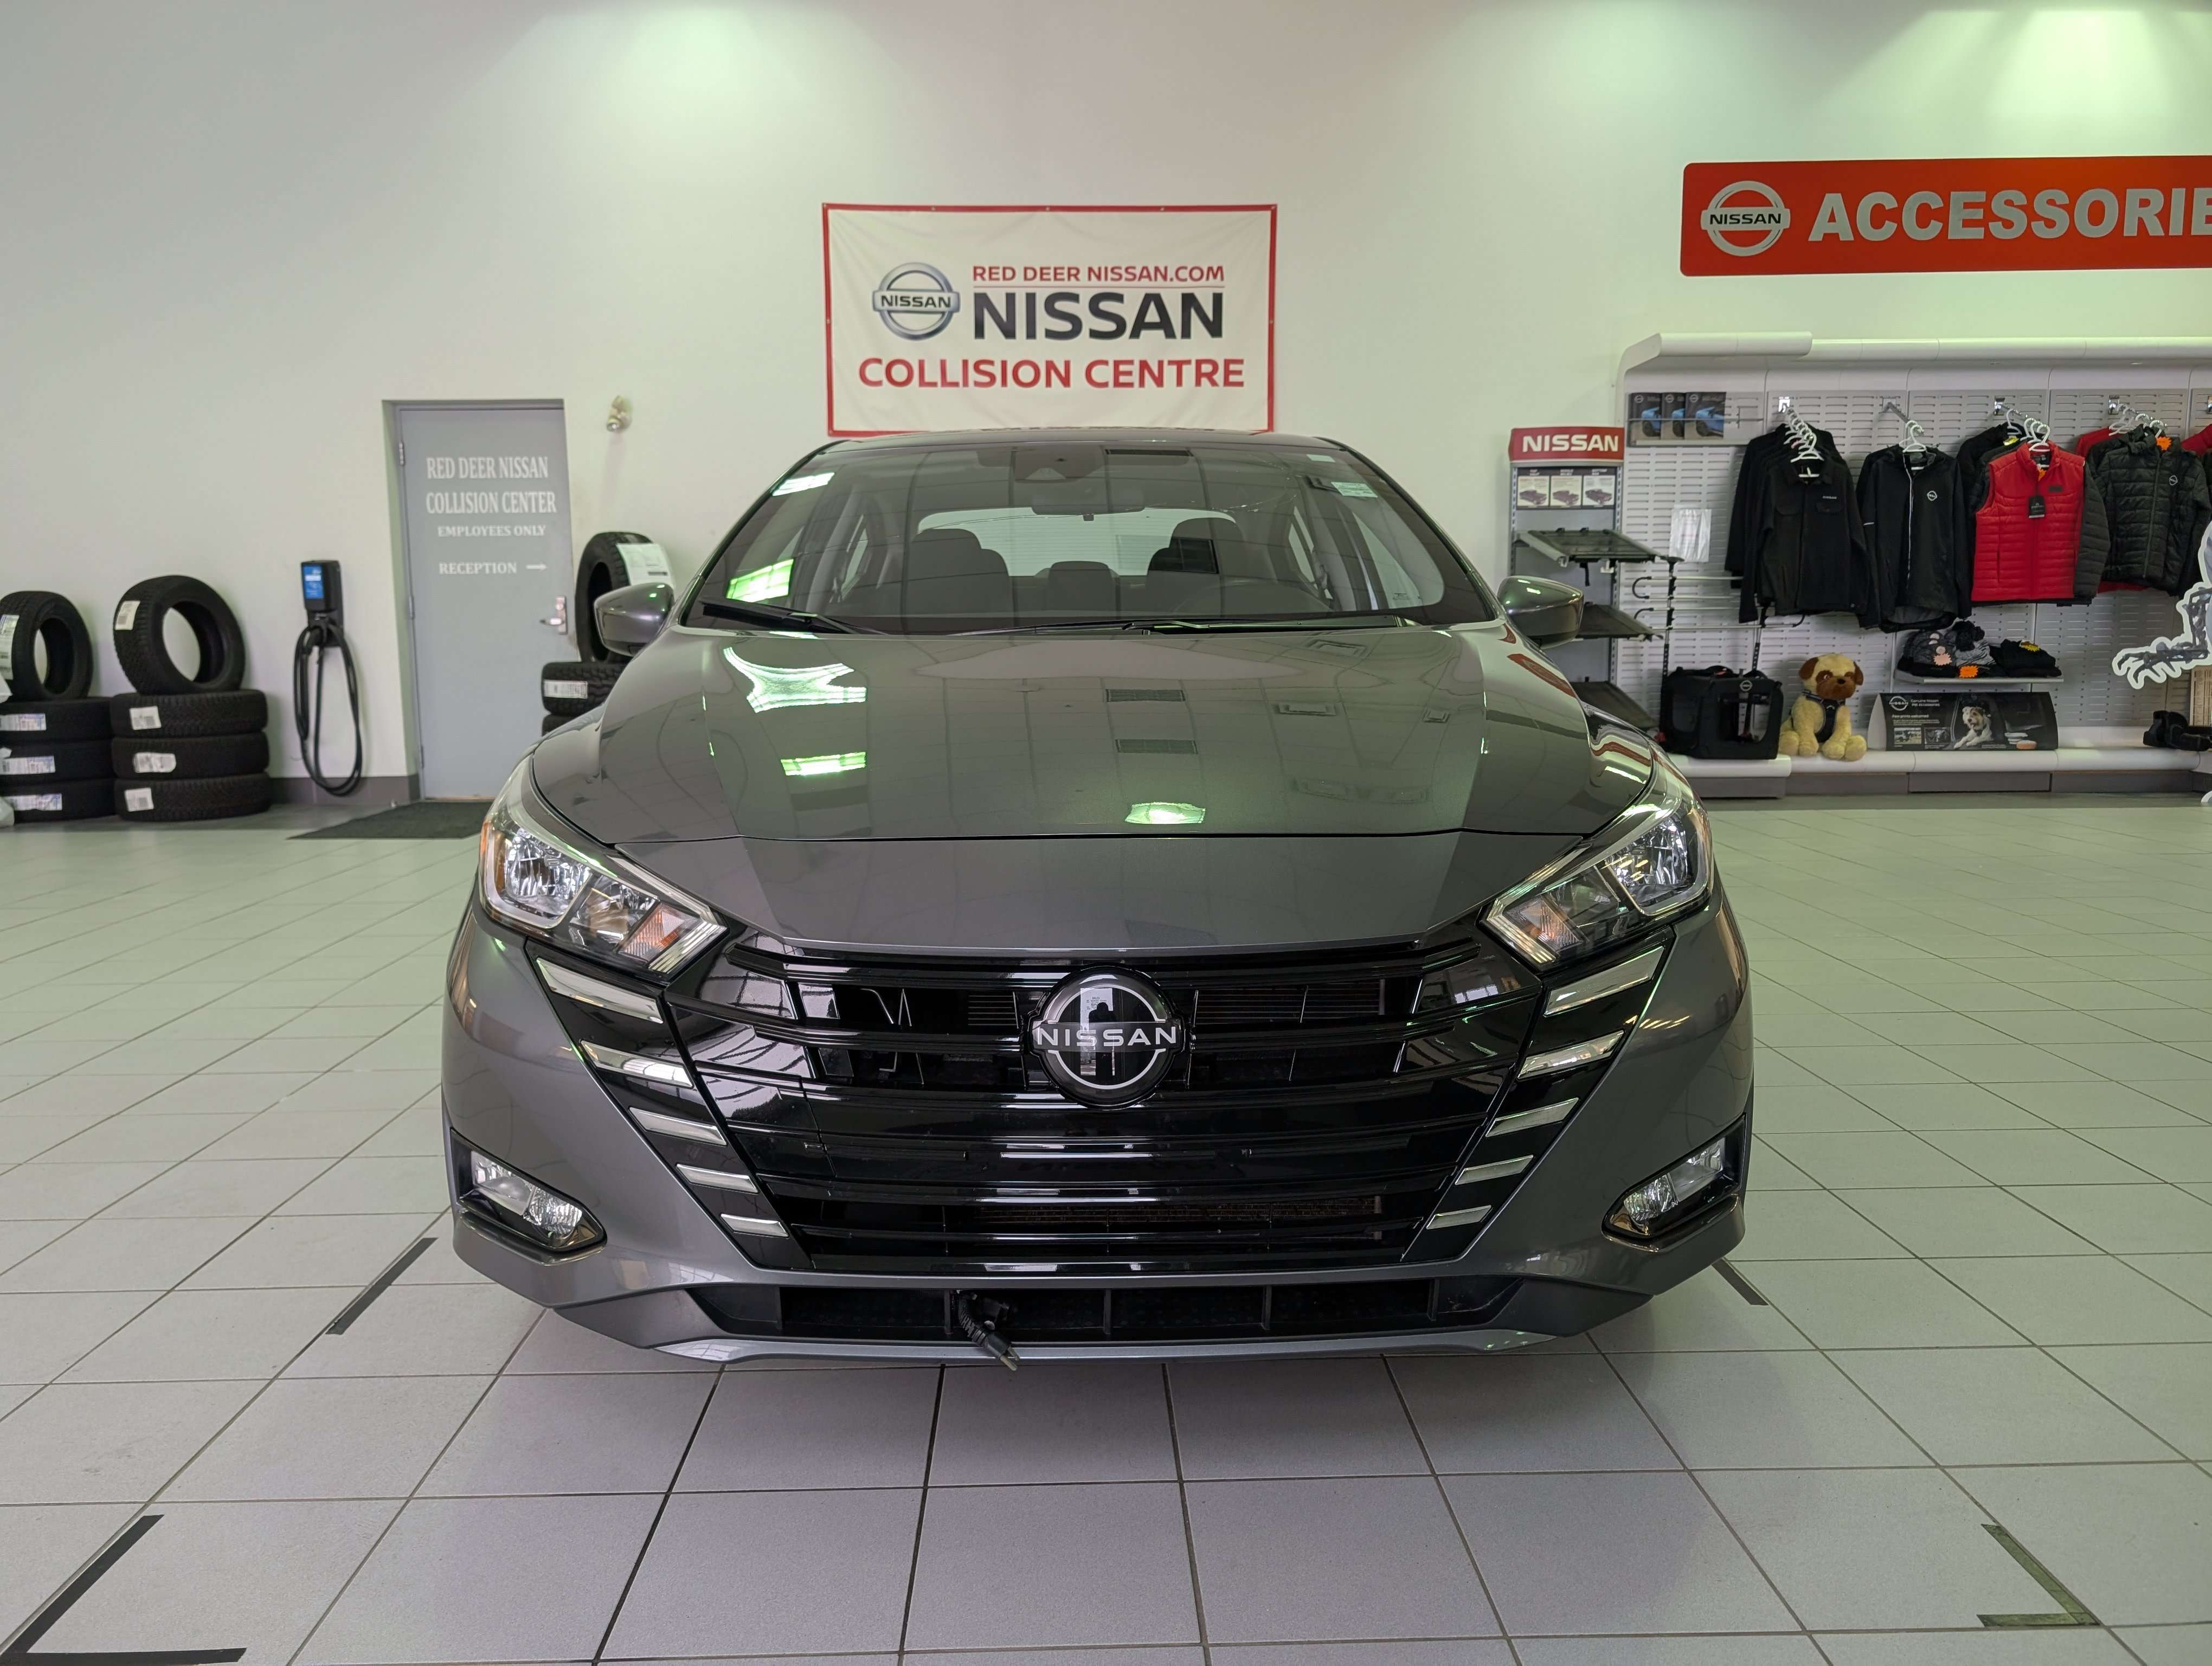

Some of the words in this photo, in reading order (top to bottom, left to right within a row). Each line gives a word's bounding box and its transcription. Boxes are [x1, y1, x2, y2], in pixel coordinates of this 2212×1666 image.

[1709, 213, 1782, 225] NISSAN
[973, 266, 1015, 281] RED
[1024, 266, 1080, 281] DEER
[1088, 265, 1225, 281] NISSAN.COM
[880, 294, 951, 309] NISSAN
[973, 291, 1224, 340] NISSAN
[859, 358, 1071, 388] COLLISION
[1085, 358, 1244, 388] CENTRE
[1522, 434, 1618, 453] NISSAN
[426, 457, 454, 479] RED
[458, 457, 496, 478] DEER
[499, 457, 548, 478] NISSAN
[426, 492, 498, 514] COLLISION
[502, 491, 557, 513] CENTER
[438, 526, 511, 537] EMPLOYEES
[514, 525, 546, 536] ONLY
[439, 562, 517, 574] RECEPTION
[1037, 1026, 1176, 1047] NISSAN
